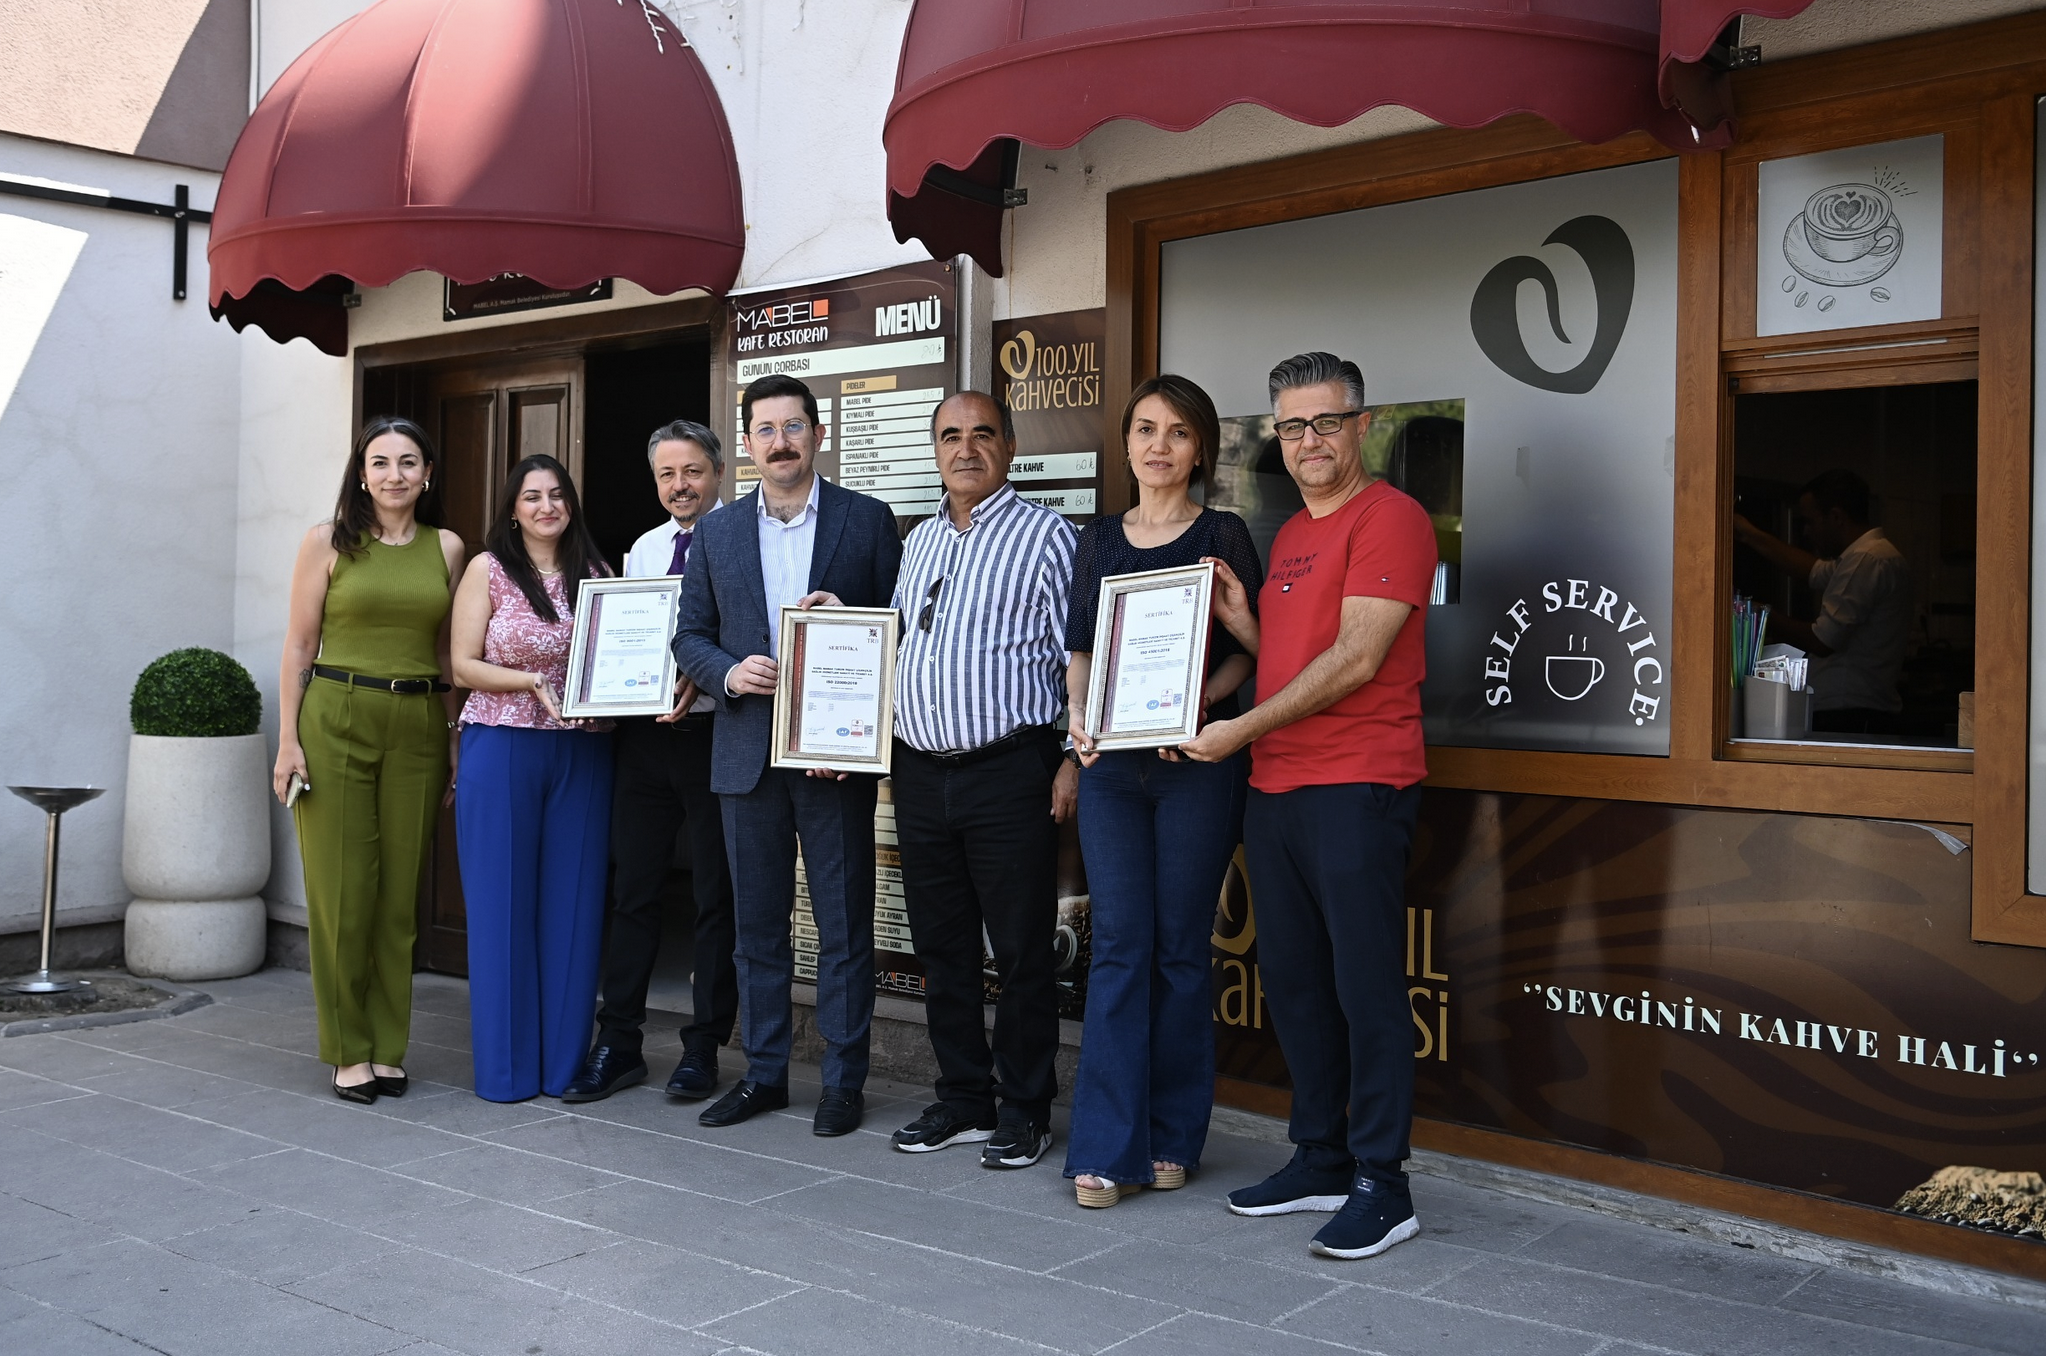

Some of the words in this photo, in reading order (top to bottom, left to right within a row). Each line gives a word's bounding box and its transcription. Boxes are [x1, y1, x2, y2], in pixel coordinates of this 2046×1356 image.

[517, 296, 541, 304] Belediyesi
[737, 301, 829, 332] MABEL
[875, 295, 941, 337] MENÜ
[738, 334, 765, 352] KAFE
[768, 326, 829, 348] RESTORAN
[1036, 342, 1100, 377] 100.YIL
[742, 361, 773, 377] GÜNÜN
[846, 381, 866, 390] PİDELER
[865, 410, 875, 418] PİDE
[869, 423, 879, 431] PİDE
[846, 439, 864, 447] KAŞARLI
[869, 451, 879, 459] PİDE
[845, 466, 859, 474] BEYAZ
[880, 464, 890, 472] PİDE
[1009, 463, 1022, 474] LTRE
[1023, 462, 1044, 473] KAHVE
[845, 480, 865, 488] SUCUKLU
[866, 479, 876, 487] PİDE
[1044, 497, 1065, 507] KAHVE
[1280, 552, 1318, 568] TOMMY
[1270, 564, 1312, 581] HILFIGER
[1484, 598, 1532, 706] SELF
[887, 911, 903, 921] AYRAN
[875, 924, 887, 933] ADEN
[887, 926, 900, 935] SUYU
[874, 938, 889, 947] EYVELİ
[890, 940, 902, 950] SODA
[799, 954, 815, 962] SAHLEP
[799, 967, 817, 976] CAPPUC
[1738, 1011, 1879, 1059] KAHVE
